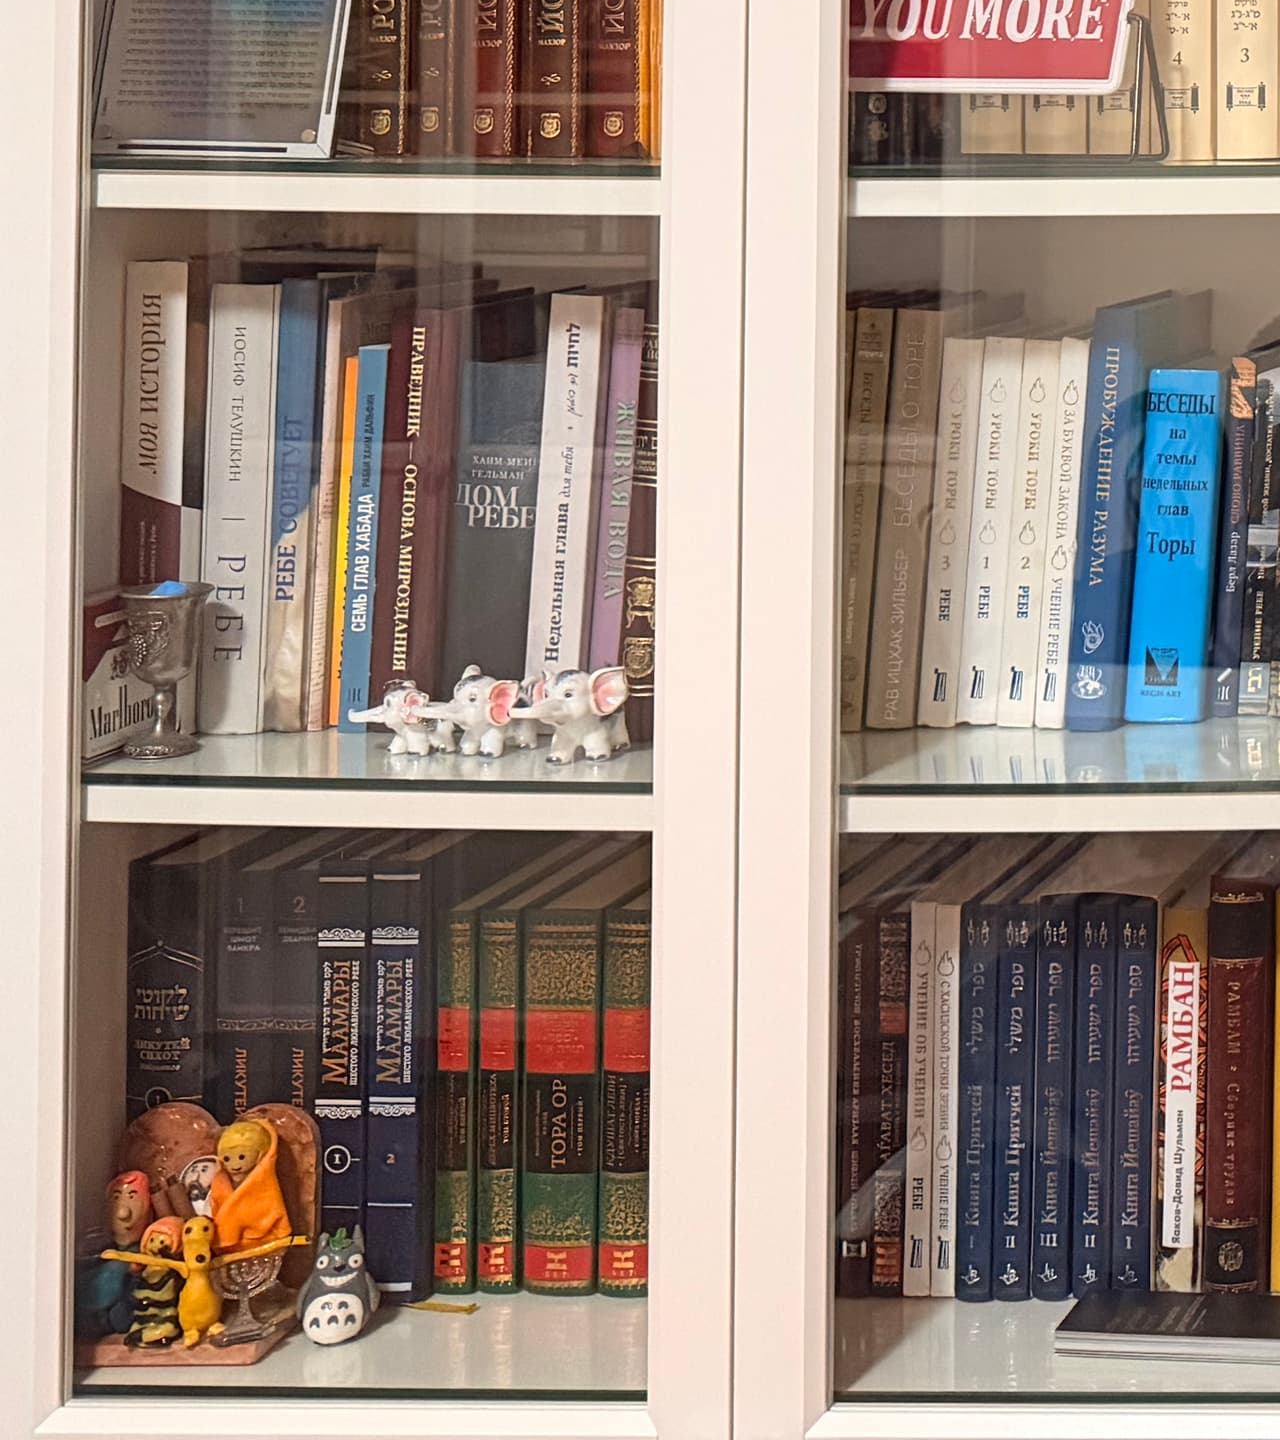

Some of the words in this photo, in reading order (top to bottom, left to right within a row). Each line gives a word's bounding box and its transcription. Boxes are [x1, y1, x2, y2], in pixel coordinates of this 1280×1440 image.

[1240, 48, 1250, 64] 3
[140, 294, 164, 412] ИСТОРИЯ
[232, 326, 246, 386] ИОСИФ
[406, 326, 426, 436] ПРАВЕДНИК
[1148, 392, 1215, 415] БЕСЕДЫ
[229, 396, 245, 482] ТЕЛУШКИН
[1097, 346, 1120, 502] ПРОБУЖДЕНИЕ
[1170, 428, 1185, 440] на
[1144, 478, 1208, 492] недельных
[1158, 454, 1196, 466] темы
[354, 494, 373, 548] ХАБАДА
[402, 464, 418, 540] ОСНОВА
[1156, 504, 1189, 516] глав
[352, 551, 368, 585] ГЛАВ
[1090, 512, 1108, 588] РАЗУМА
[1146, 531, 1194, 558] Торы
[212, 555, 247, 661] РЕБЕ
[351, 589, 366, 632] СЕМЬ
[392, 545, 414, 672] МИРОЗДАНИЯ
[1171, 964, 1194, 1092] РАМБАН
[552, 1079, 567, 1108] ОР
[552, 1113, 567, 1168] ТОРА
